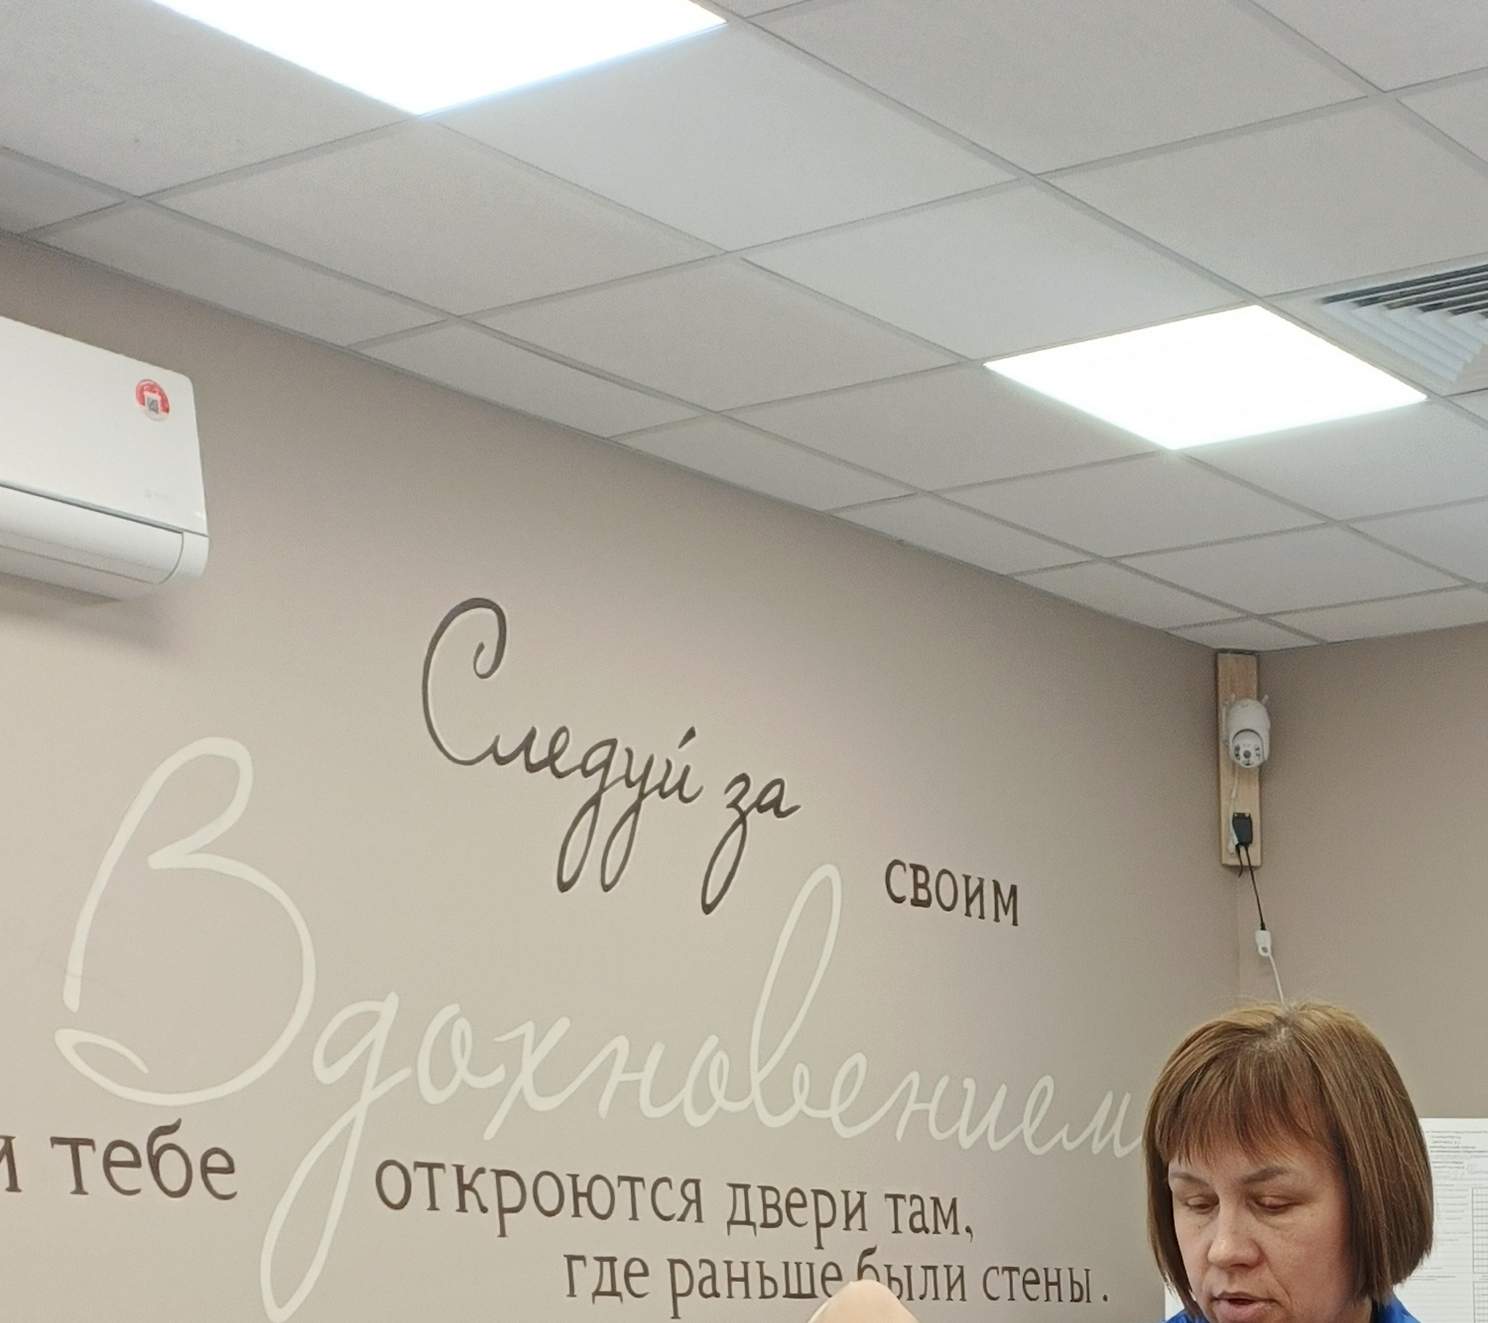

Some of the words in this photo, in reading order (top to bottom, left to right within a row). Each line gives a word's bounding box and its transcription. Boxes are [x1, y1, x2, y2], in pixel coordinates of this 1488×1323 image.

[422, 596, 704, 893] Следуй
[702, 772, 802, 915] за
[49, 1118, 239, 1200] тебе
[374, 1158, 704, 1239] откроются
[726, 1180, 867, 1249] двери
[884, 1190, 974, 1243] там,
[563, 1252, 650, 1305] где
[666, 1255, 844, 1320] раньше
